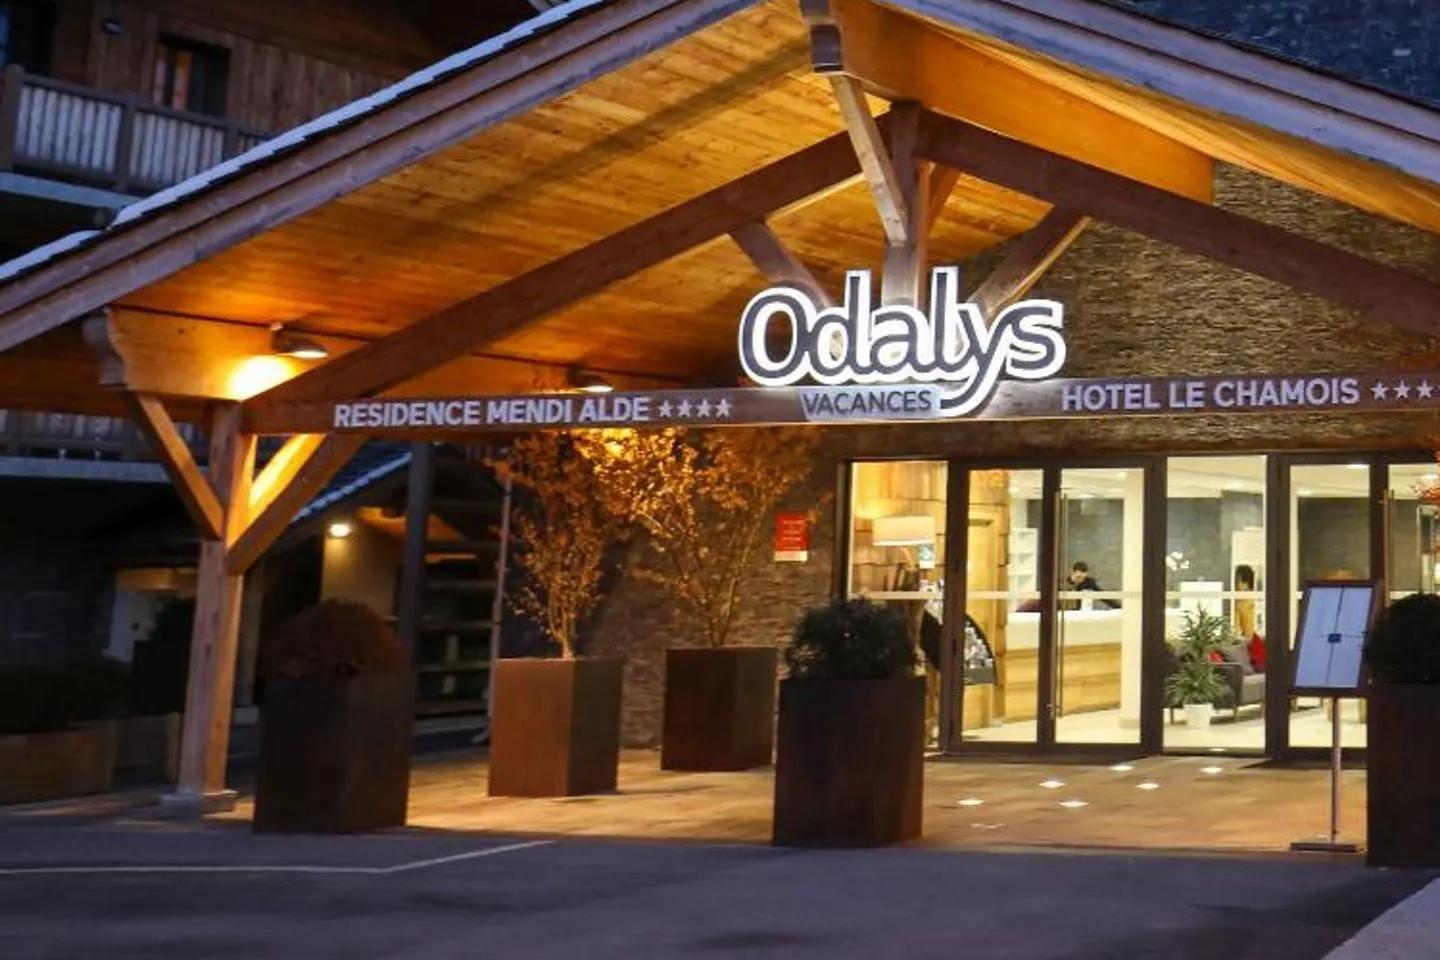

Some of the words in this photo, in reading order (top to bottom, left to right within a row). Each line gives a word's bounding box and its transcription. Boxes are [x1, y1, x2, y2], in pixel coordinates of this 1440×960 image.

[740, 266, 1067, 418] Odalys
[802, 390, 932, 415] VACANCES
[1061, 383, 1161, 411] HOTEL
[1168, 381, 1206, 408] LE
[1213, 378, 1361, 407] CHAMOIS
[333, 400, 481, 427] RESIDENCE
[486, 398, 572, 424] MENDI
[578, 396, 650, 422] ALDE
